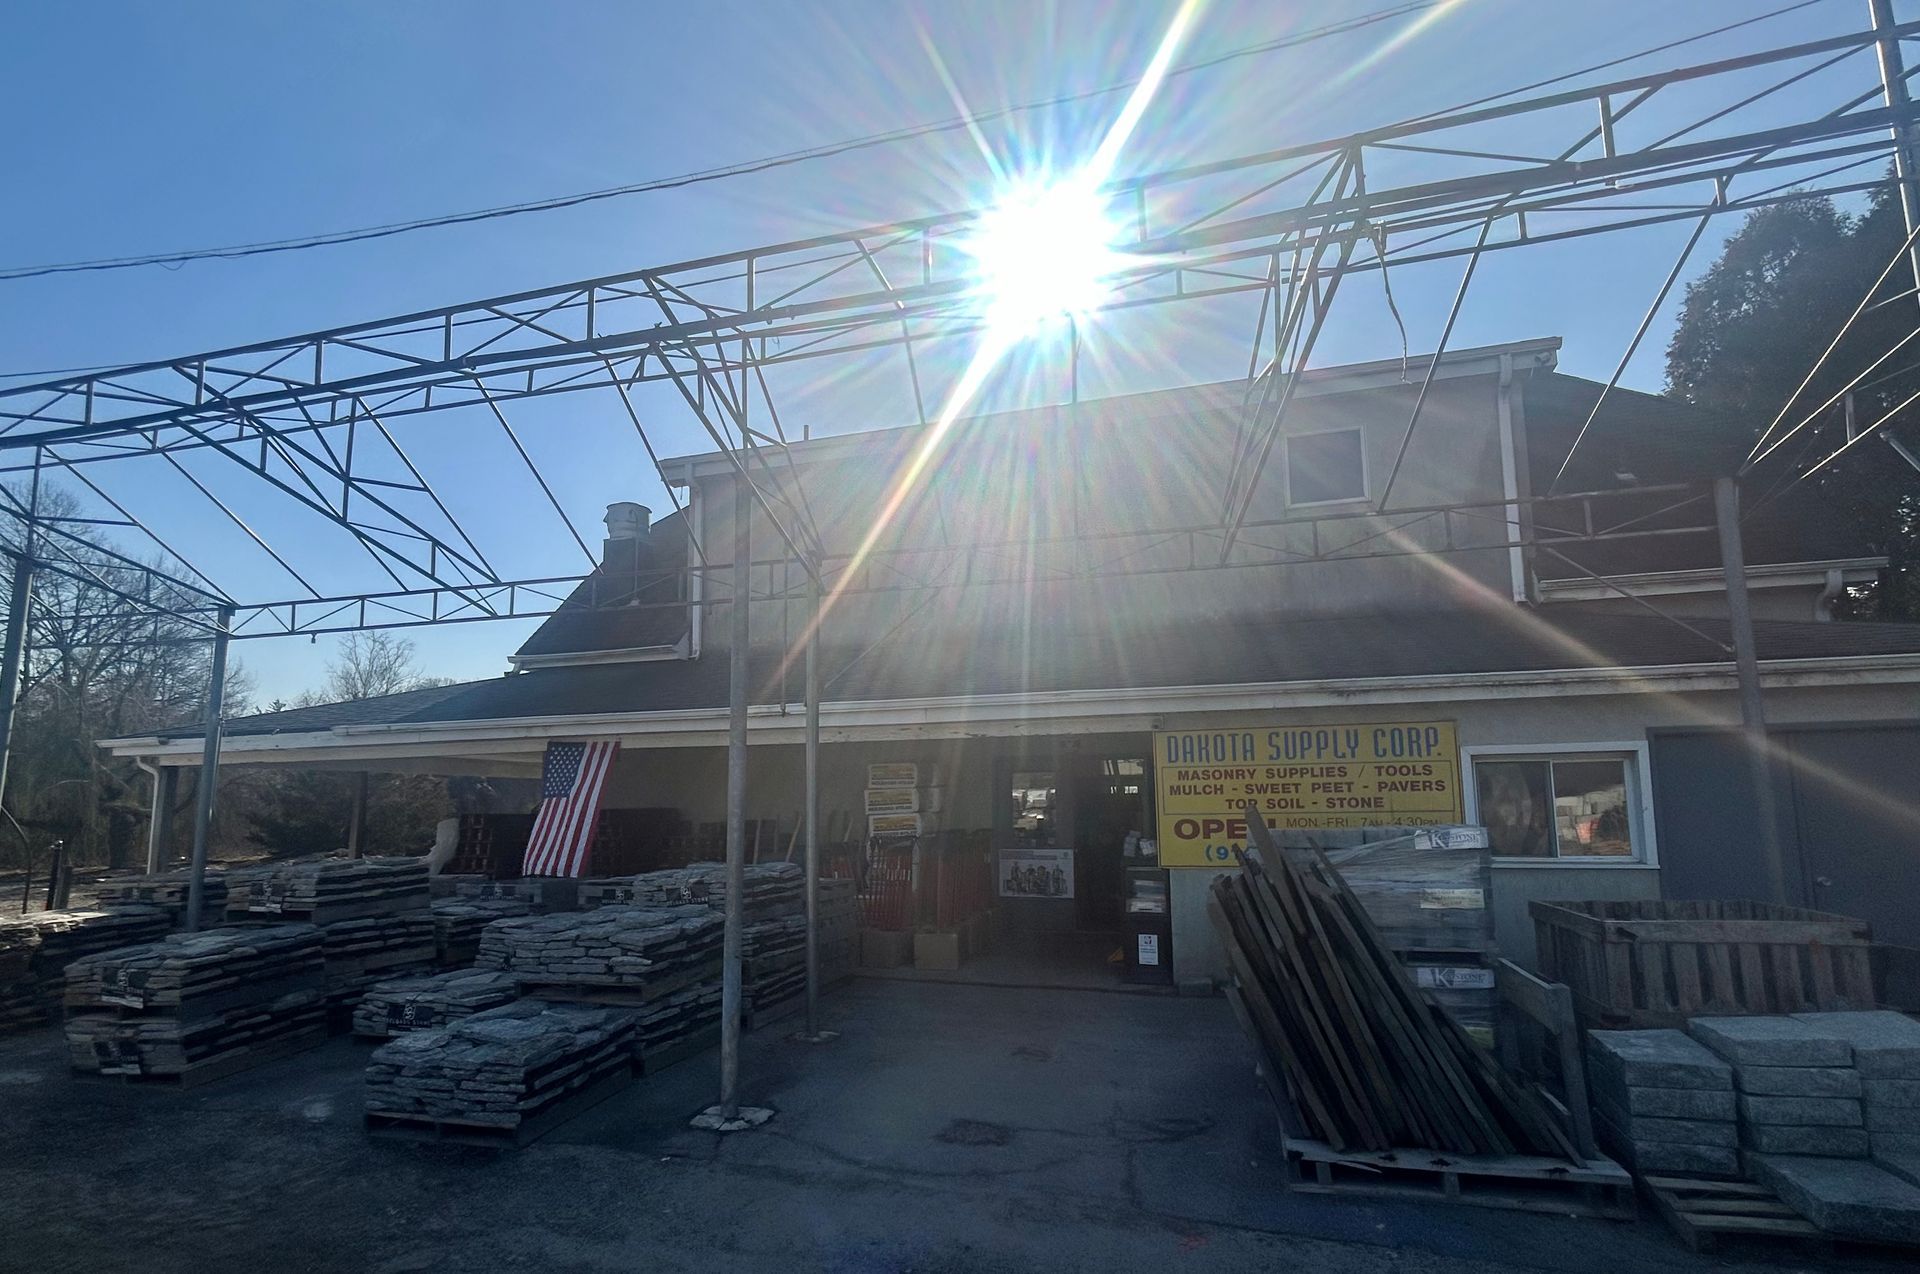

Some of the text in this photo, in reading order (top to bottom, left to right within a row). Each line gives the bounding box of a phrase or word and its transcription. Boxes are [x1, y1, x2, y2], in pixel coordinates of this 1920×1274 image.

[1166, 727, 1442, 763] DAKOTA SUPPLY CORP.
[1177, 768, 1256, 781] MASONRY
[1265, 766, 1348, 779] SUPPLIES
[1374, 764, 1433, 777] TOOLS
[1169, 784, 1224, 796] MULCH
[1244, 783, 1301, 795] SWEET
[1311, 781, 1354, 793] PEET
[1377, 780, 1446, 793] PAVERS
[1266, 797, 1305, 809] SOIL
[1326, 796, 1384, 809] STONE
[1173, 818, 1276, 840] OPE
